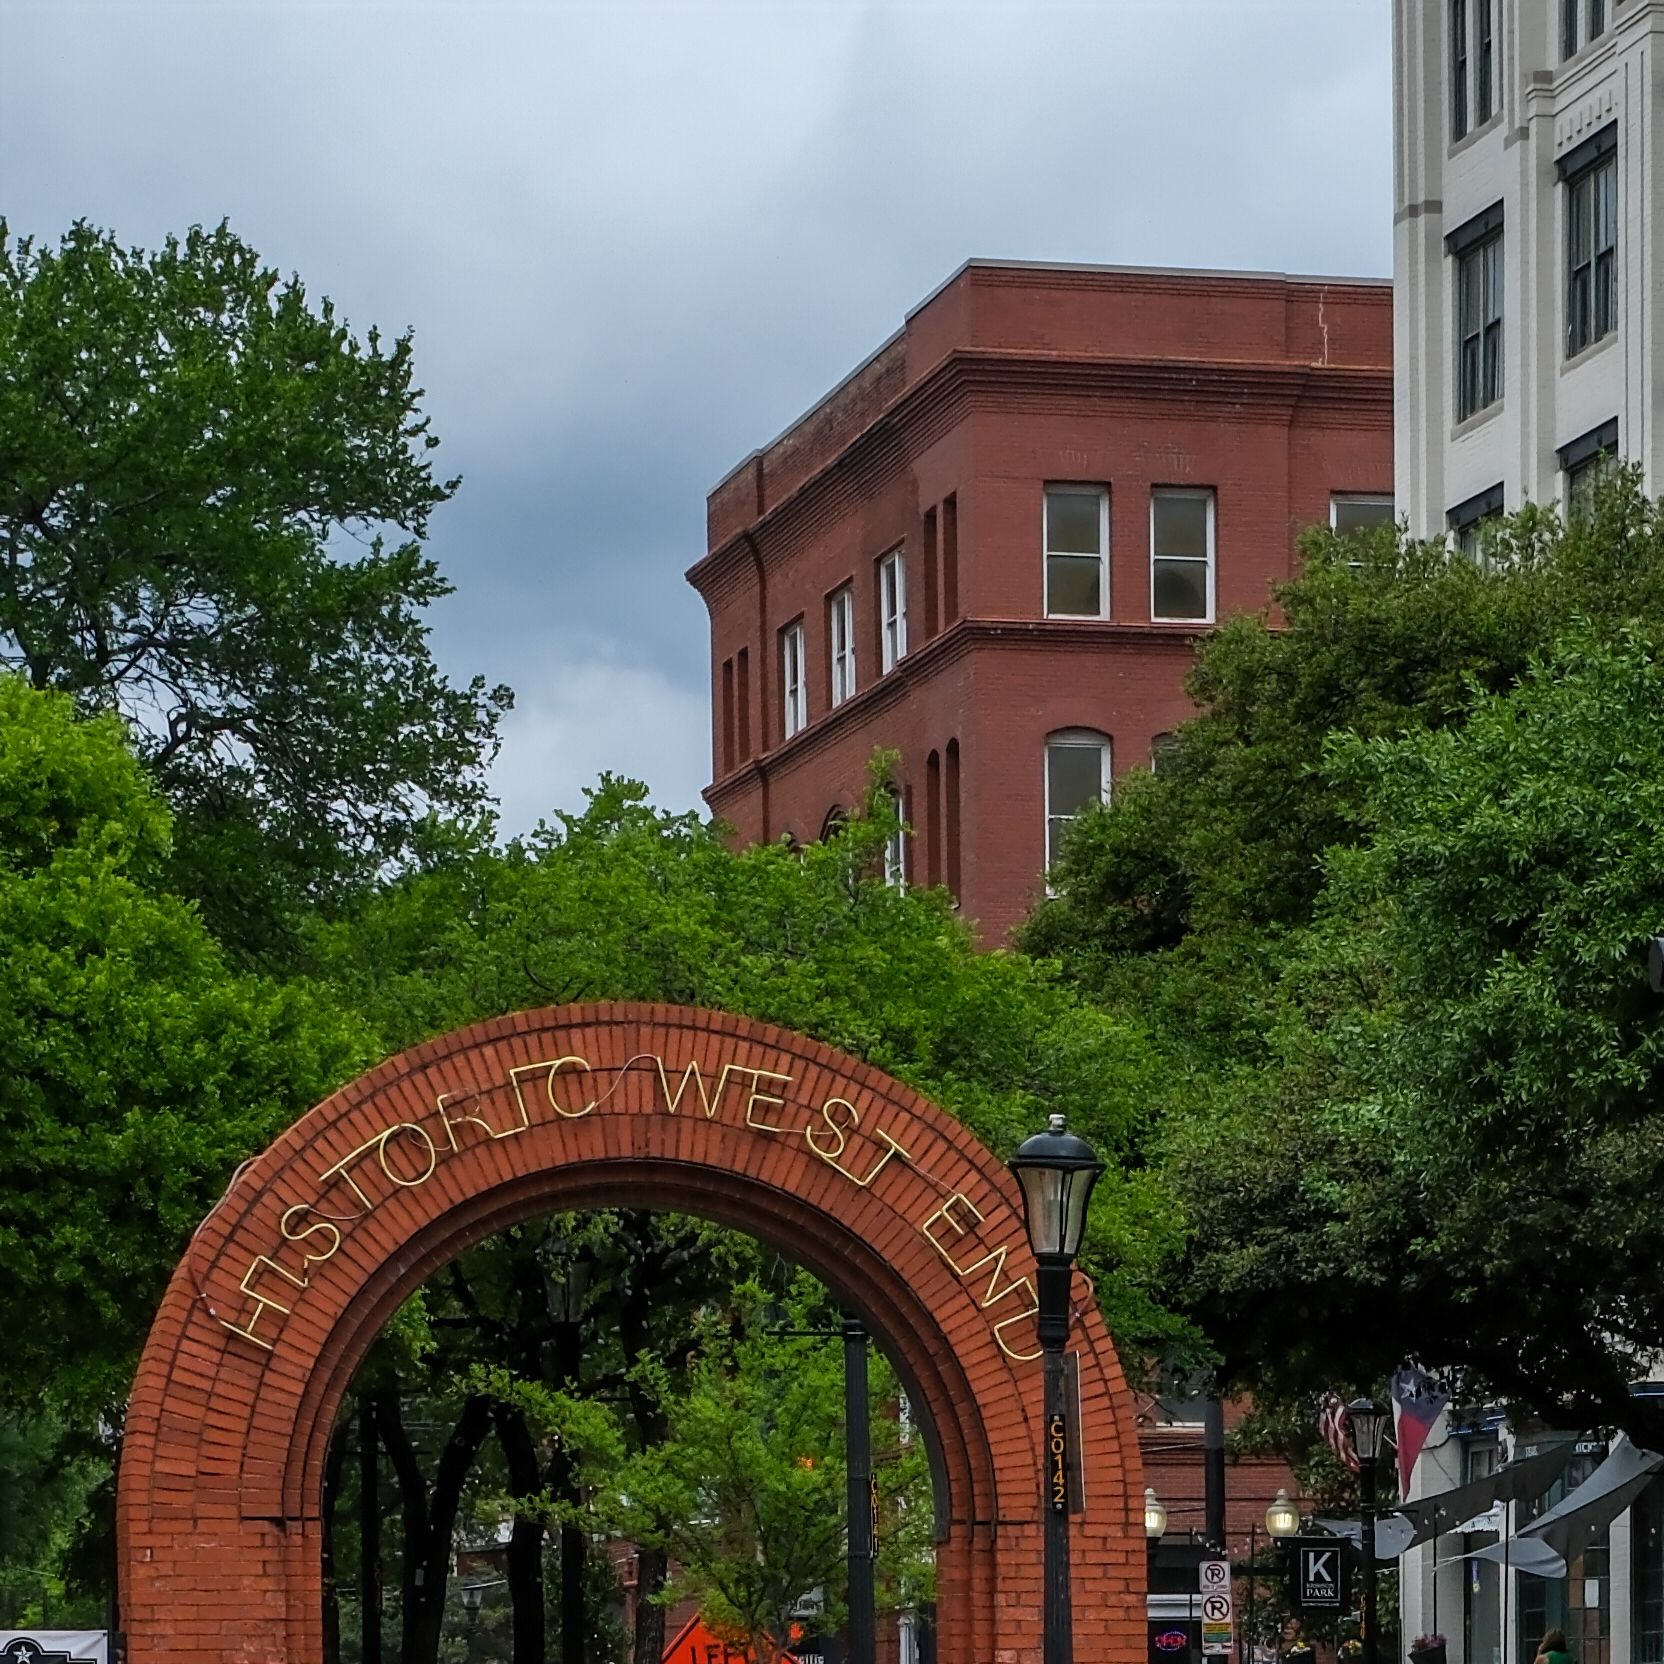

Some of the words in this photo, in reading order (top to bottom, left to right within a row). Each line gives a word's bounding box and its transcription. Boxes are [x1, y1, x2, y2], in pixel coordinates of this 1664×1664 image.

[219, 1055, 596, 1351] HISTORIC
[654, 1055, 912, 1186] WEST
[921, 1192, 1044, 1361] END
[1308, 1551, 1332, 1582] K
[1306, 1588, 1335, 1597] PARK
